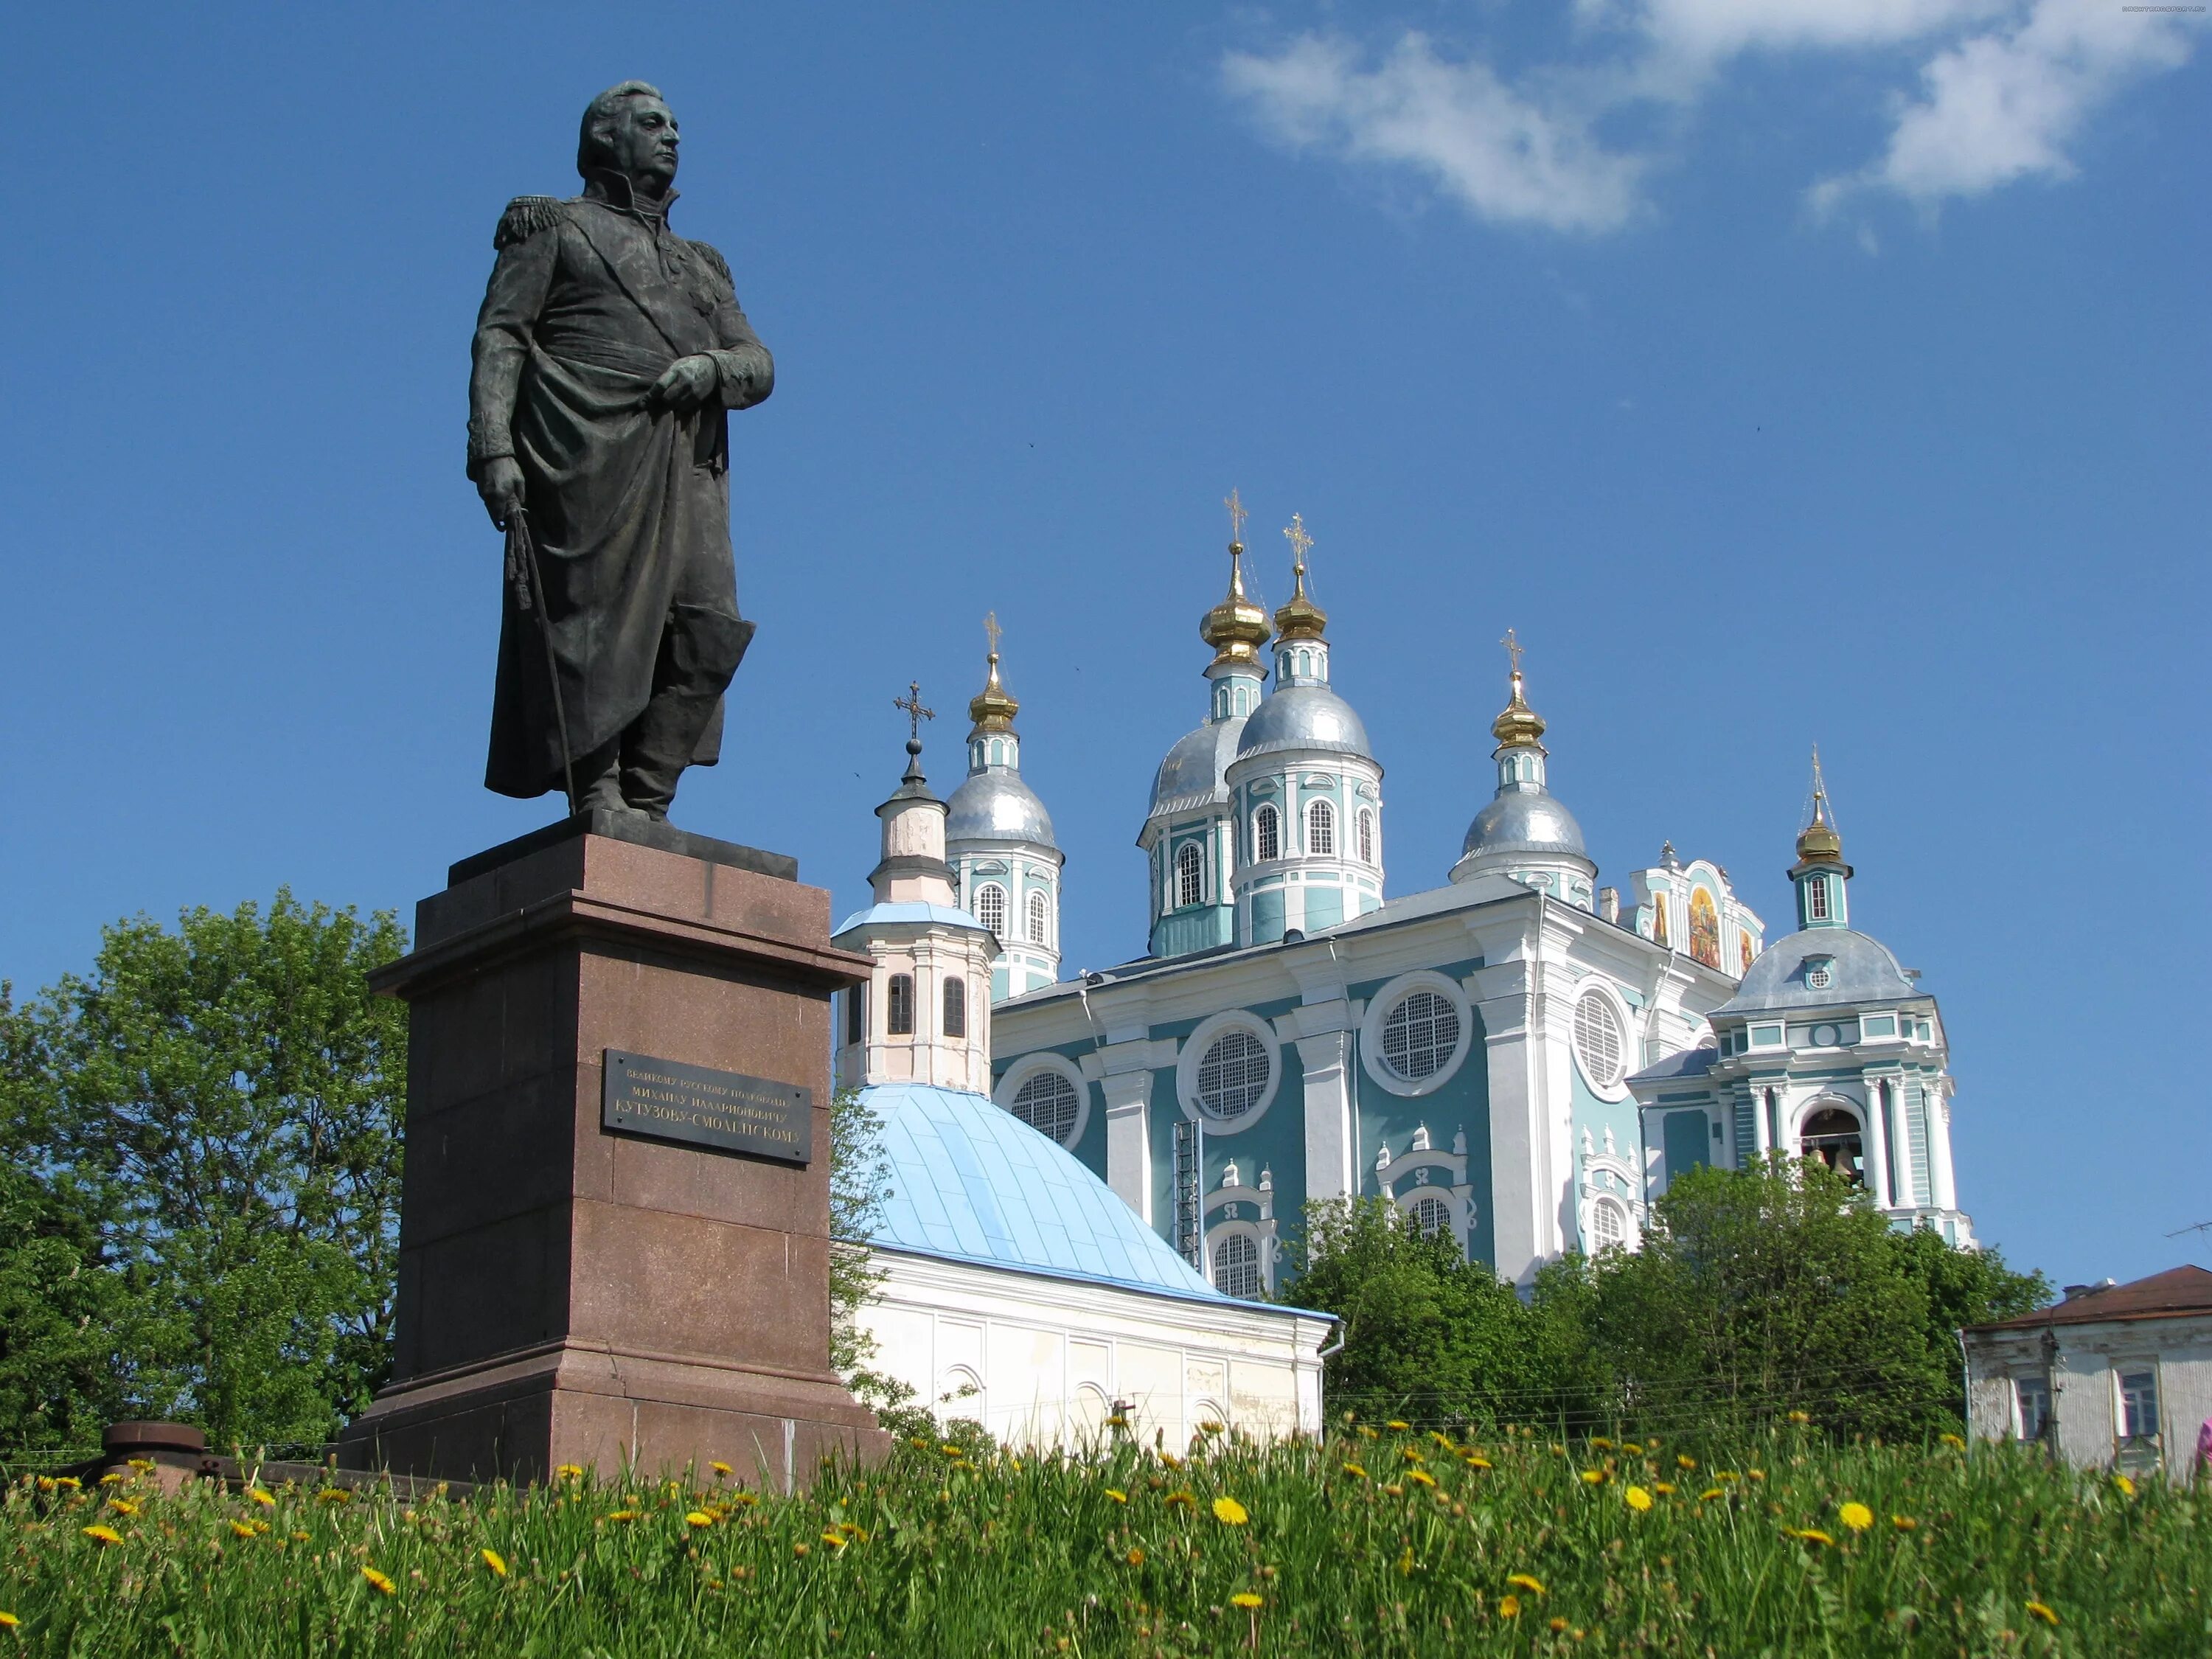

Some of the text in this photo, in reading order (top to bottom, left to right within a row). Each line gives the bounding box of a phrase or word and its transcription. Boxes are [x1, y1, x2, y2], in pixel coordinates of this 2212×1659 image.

[626, 1068, 677, 1085] ВЕЛИКОМУ
[681, 1079, 728, 1095] РУССКОМУ
[614, 1099, 800, 1143] КУТУЗОВУ-СМОЛЕНСКОМУ
[692, 1097, 787, 1123] ИЛЛАРИОНОВИЧУ
